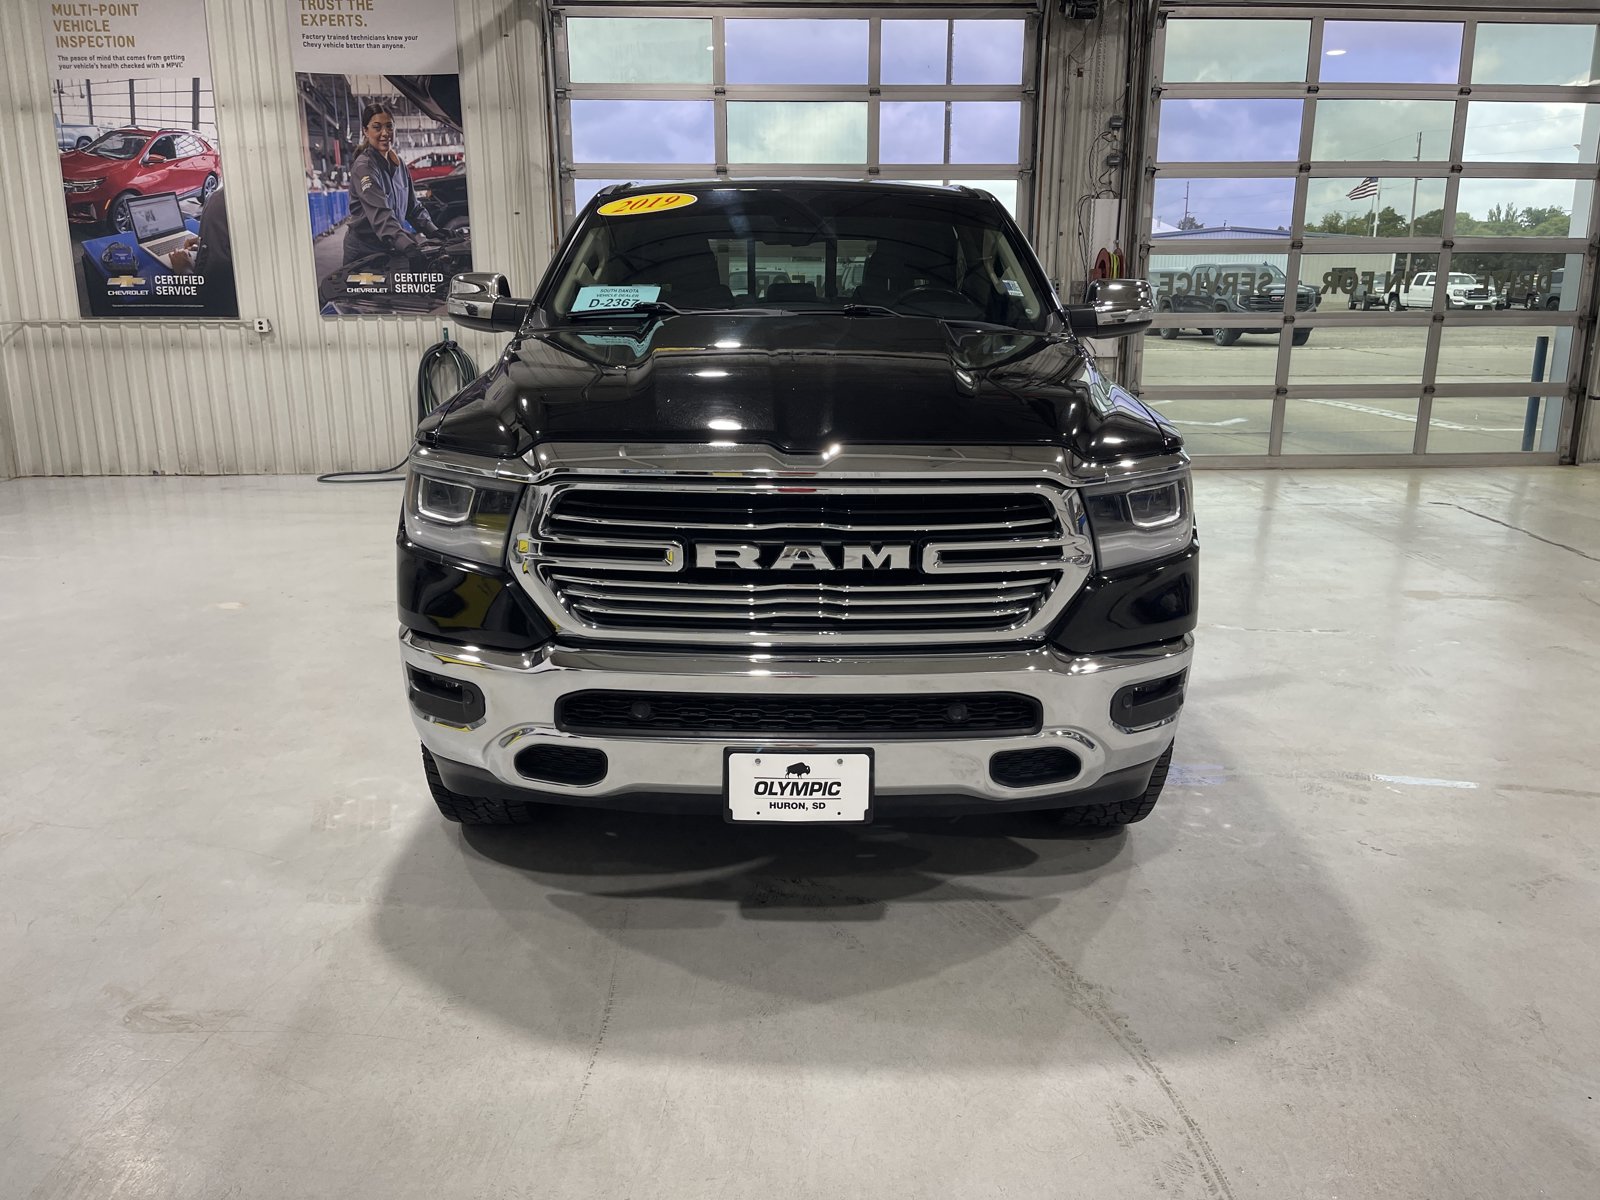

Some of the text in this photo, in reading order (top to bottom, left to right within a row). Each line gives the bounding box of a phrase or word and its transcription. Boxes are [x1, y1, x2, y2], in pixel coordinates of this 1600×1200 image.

[52, 3, 139, 17] MULTI-POINT
[299, 0, 374, 11] TRUST THE
[53, 19, 111, 33] VEHICLE
[300, 14, 368, 27] EXPERTS.
[55, 35, 136, 48] INSPECTION
[302, 33, 326, 42] Factory
[302, 42, 321, 50] Chevy
[381, 43, 406, 51] anyone.
[74, 62, 99, 70] vehicle's
[612, 195, 681, 214] 2019
[154, 275, 206, 286] CERTIFIED
[394, 273, 445, 283] CERTIFIED
[156, 286, 198, 296] SERVICE
[395, 283, 437, 294] SERVICE
[588, 299, 641, 308] D-2367
[696, 543, 911, 570] RAM
[754, 781, 842, 796] OLYMPIC
[769, 802, 826, 811] HURON, SD
